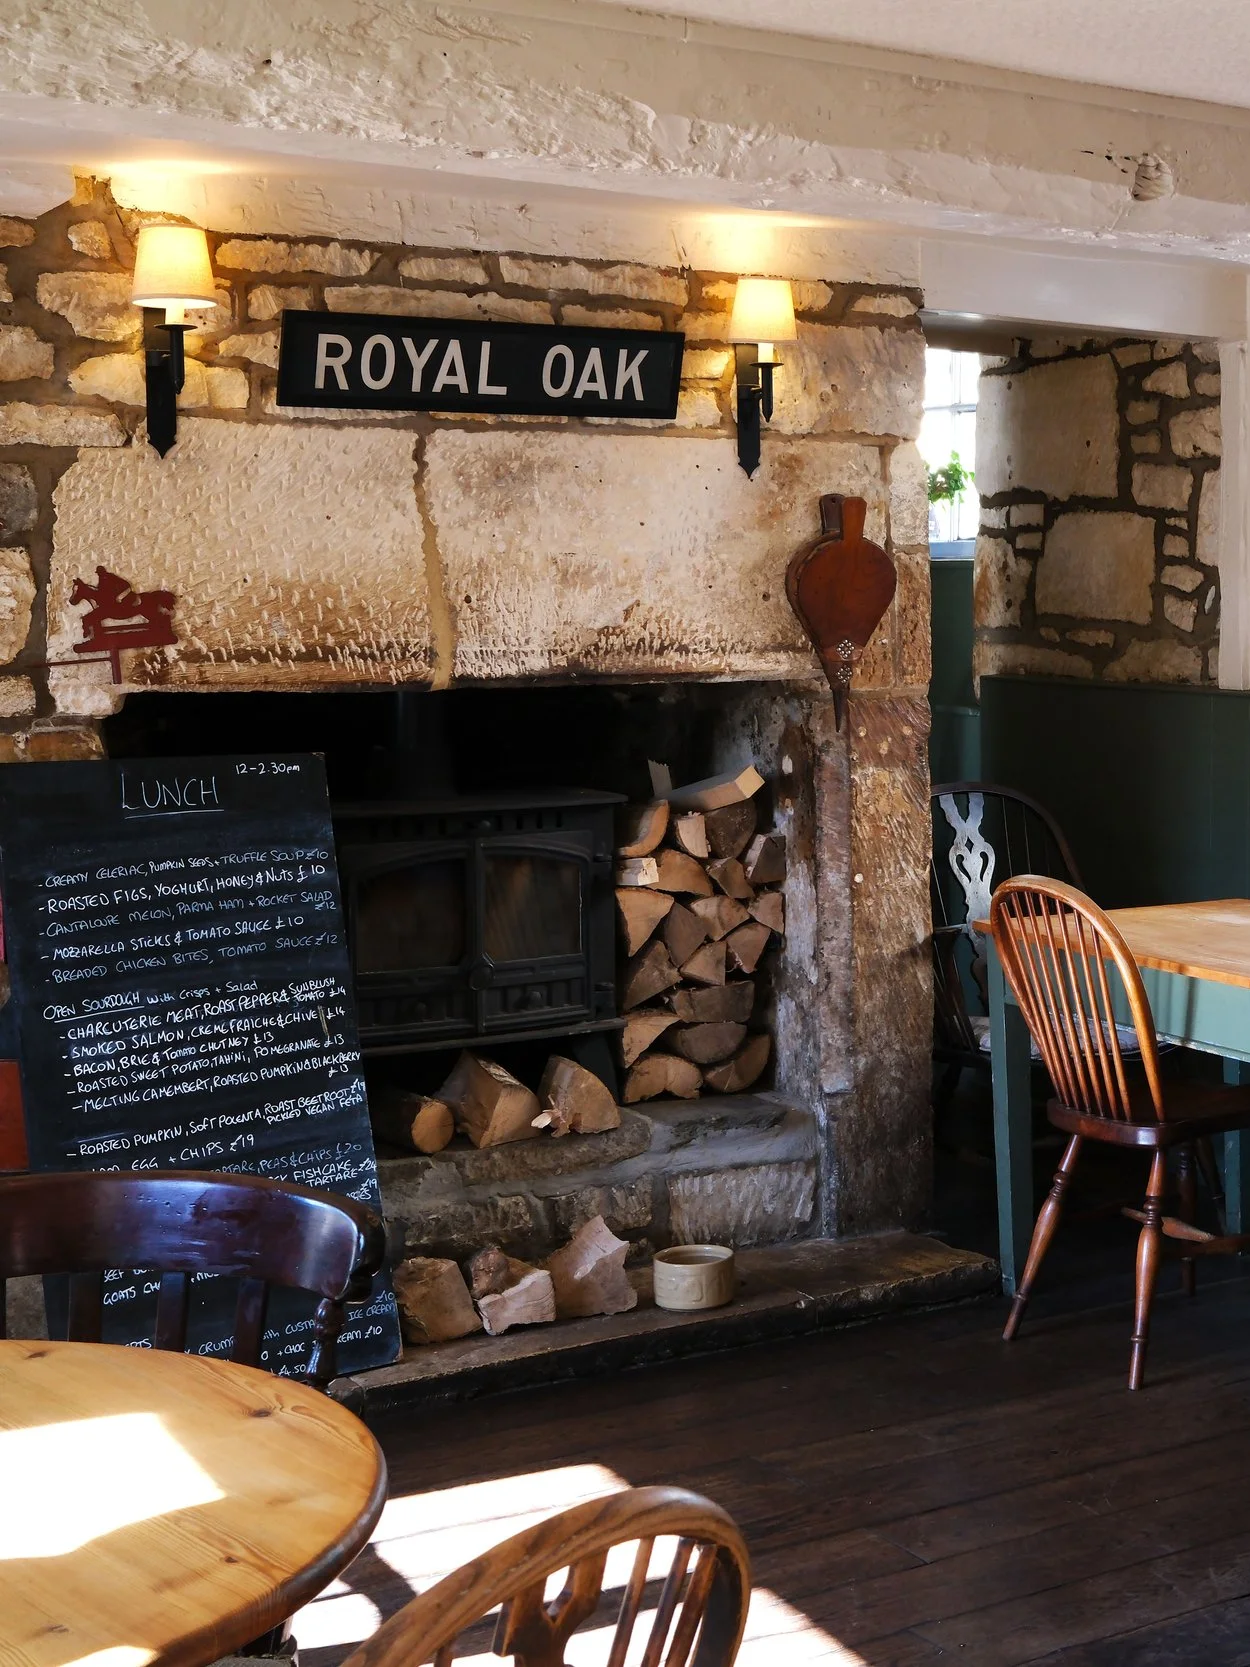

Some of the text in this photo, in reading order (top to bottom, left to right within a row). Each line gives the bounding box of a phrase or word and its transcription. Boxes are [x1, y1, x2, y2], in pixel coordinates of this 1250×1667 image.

[314, 334, 649, 401] ROYAL OAK
[121, 773, 219, 810] LUNCH
[45, 872, 89, 889] CREAMY
[149, 858, 185, 874] PUMPKIN
[220, 851, 267, 865] TRUFFLE
[270, 849, 304, 864] SOUP
[46, 914, 120, 937] CANTALOUPE
[177, 901, 215, 918] PARMA
[219, 898, 244, 912] HAM
[256, 894, 298, 909] ROCKET
[301, 890, 333, 904] SALAD
[48, 893, 110, 915] ROASTED
[53, 916, 304, 961] MOZZARELLA TOMATO SAUCE £10
[52, 967, 109, 984] BREADED
[116, 956, 167, 973] CHICKEN
[217, 942, 267, 959] TOMATO
[275, 936, 313, 950] SAUCE
[43, 1004, 76, 1021] OPEN
[83, 991, 140, 1013] SOURDOUGH
[67, 1015, 163, 1040] CHARCUTERIE
[204, 998, 236, 1017] ROAST
[238, 991, 282, 1012] PEPPER
[289, 977, 336, 996] SUNBLUSH
[72, 1040, 127, 1059] SMOKED
[191, 1021, 229, 1037] CREME
[286, 1010, 319, 1026] CHIVE
[77, 1076, 128, 1094] ROASTED
[131, 1065, 168, 1083] SWEET
[254, 1039, 321, 1059] POMEGRANATE
[120, 1053, 149, 1070] BRIE
[200, 1037, 249, 1054] CHUTNEY
[84, 1091, 140, 1113] MELTING
[213, 1071, 259, 1090] ROASTED
[312, 1051, 361, 1069] BLACKBERRY
[80, 1138, 131, 1156] ROASTED
[264, 1099, 296, 1116] ROAST
[297, 1089, 350, 1110] BEETROOT
[306, 1101, 335, 1117] VEGAN
[340, 1094, 363, 1108] FETA
[132, 1134, 254, 1171] EGG CHIPS £19
[260, 1156, 289, 1171] PEAS
[293, 1161, 351, 1182] FISHCAKE
[305, 1169, 358, 1188] TARTARE
[103, 1286, 136, 1306] GOATS
[347, 1302, 396, 1322] ICE CREAM
[284, 1342, 305, 1355] CHOC
